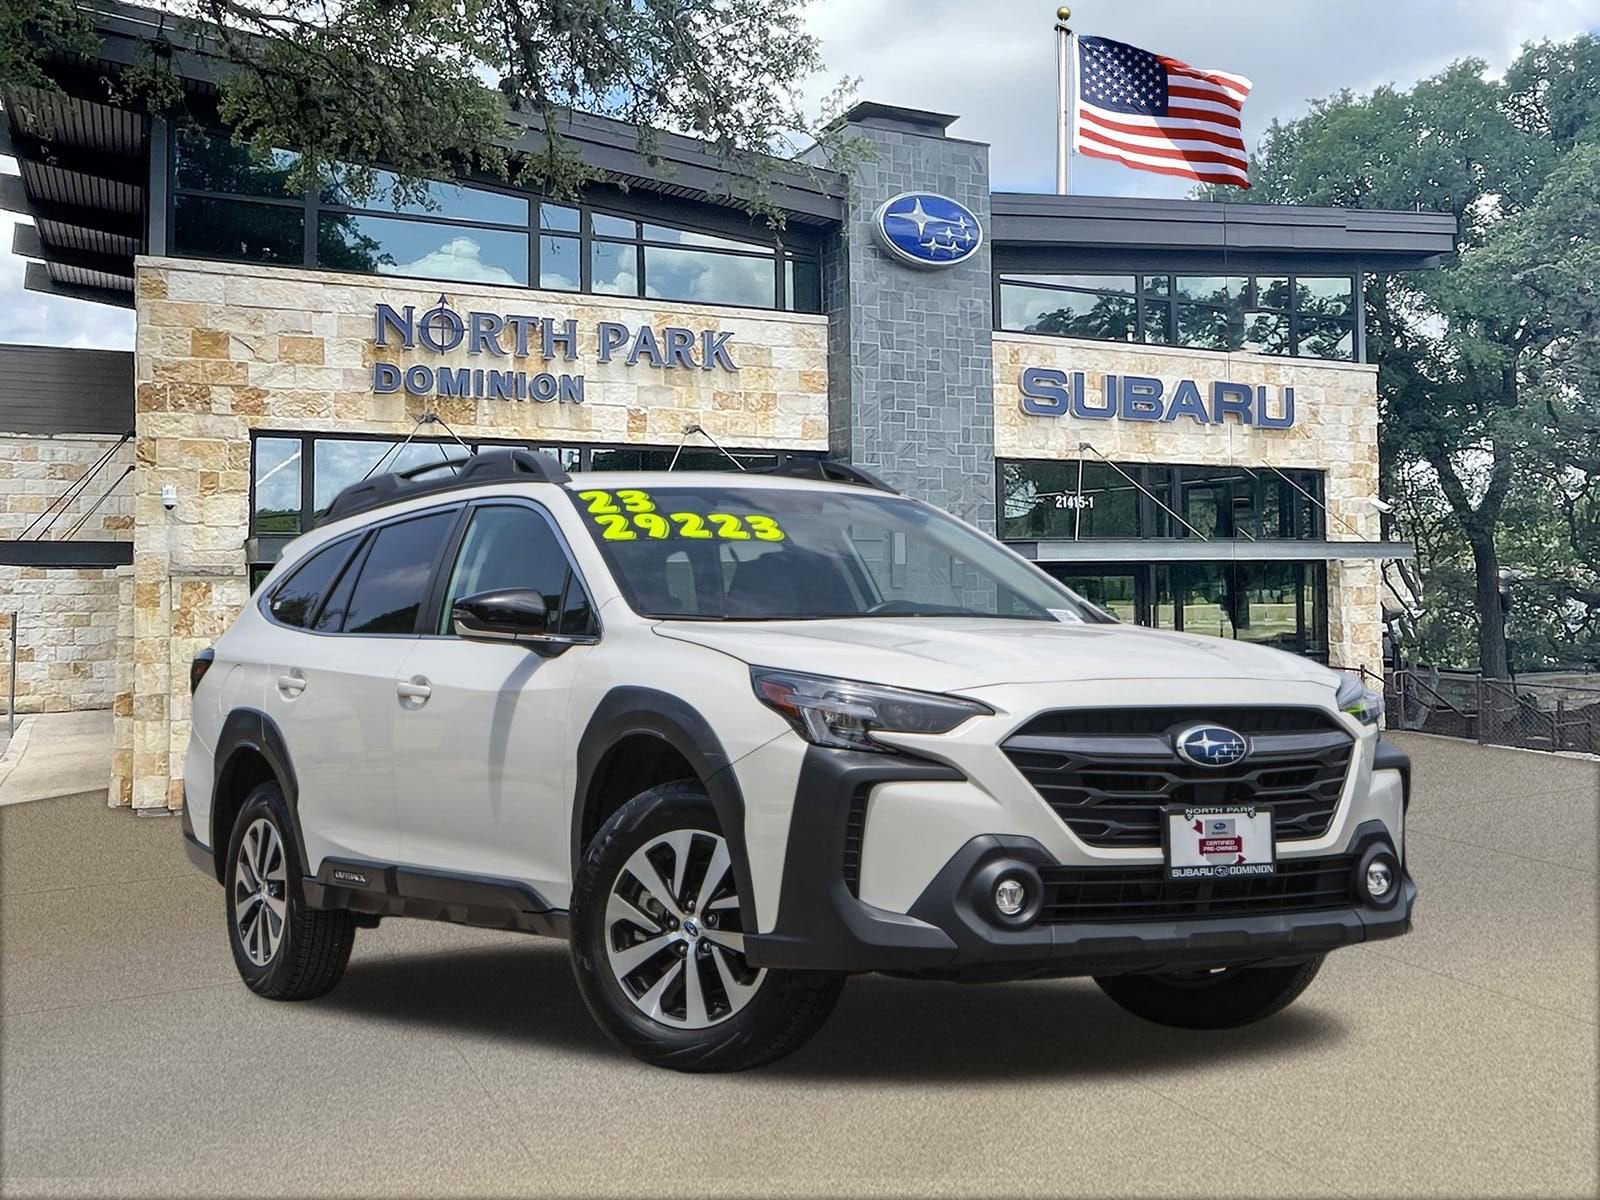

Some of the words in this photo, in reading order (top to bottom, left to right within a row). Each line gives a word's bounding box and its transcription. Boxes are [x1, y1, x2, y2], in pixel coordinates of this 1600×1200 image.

[374, 293, 580, 361] NORTH
[597, 321, 742, 373] PARK
[373, 361, 585, 404] DOMINION
[1019, 367, 1295, 429] SUBARU
[578, 489, 657, 514] 23
[594, 512, 785, 541] 29223
[1185, 807, 1223, 815] NORTH
[1226, 806, 1255, 814] PARK
[1205, 839, 1235, 847] CERTIFIED
[1171, 867, 1214, 877] SUBARU
[1230, 865, 1274, 875] DOMINION
